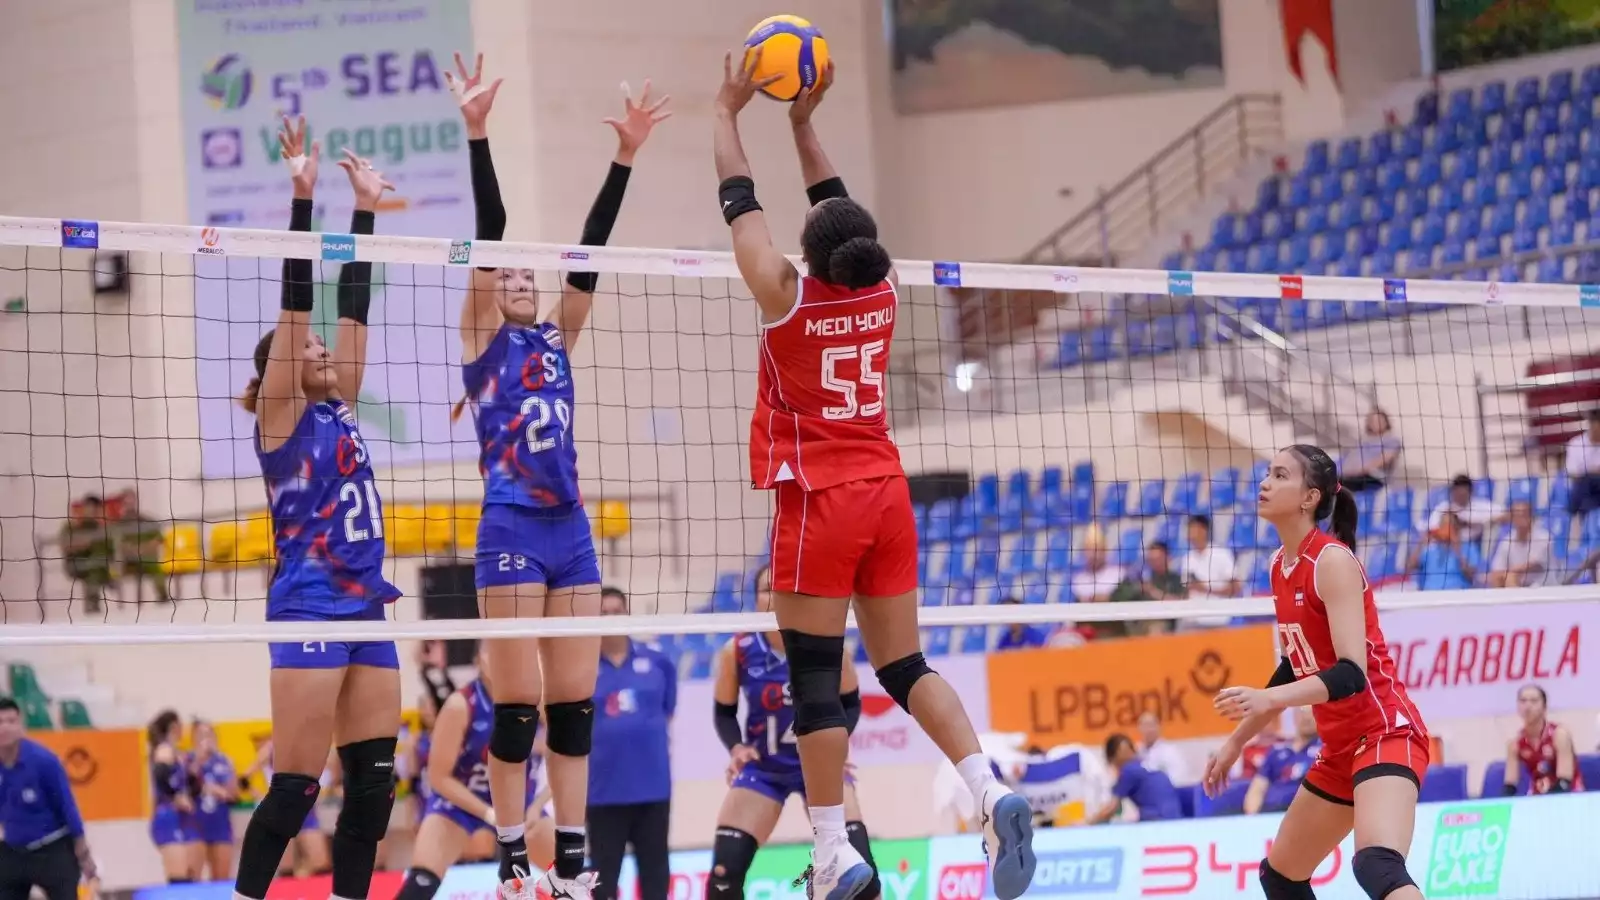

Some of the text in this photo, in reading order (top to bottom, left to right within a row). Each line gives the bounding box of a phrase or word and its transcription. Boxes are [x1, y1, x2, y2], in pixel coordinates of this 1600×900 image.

[341, 51, 442, 98] SEA
[805, 306, 893, 336] MEDI YOKU
[821, 338, 885, 420] 55
[339, 479, 384, 543] 21
[498, 552, 526, 572] 29
[1279, 622, 1321, 678] 20
[1028, 677, 1189, 734] LPBank
[468, 761, 490, 792] 2
[1434, 825, 1504, 862] EURO
[940, 870, 984, 900] ON
[1430, 852, 1498, 891] CAKE
